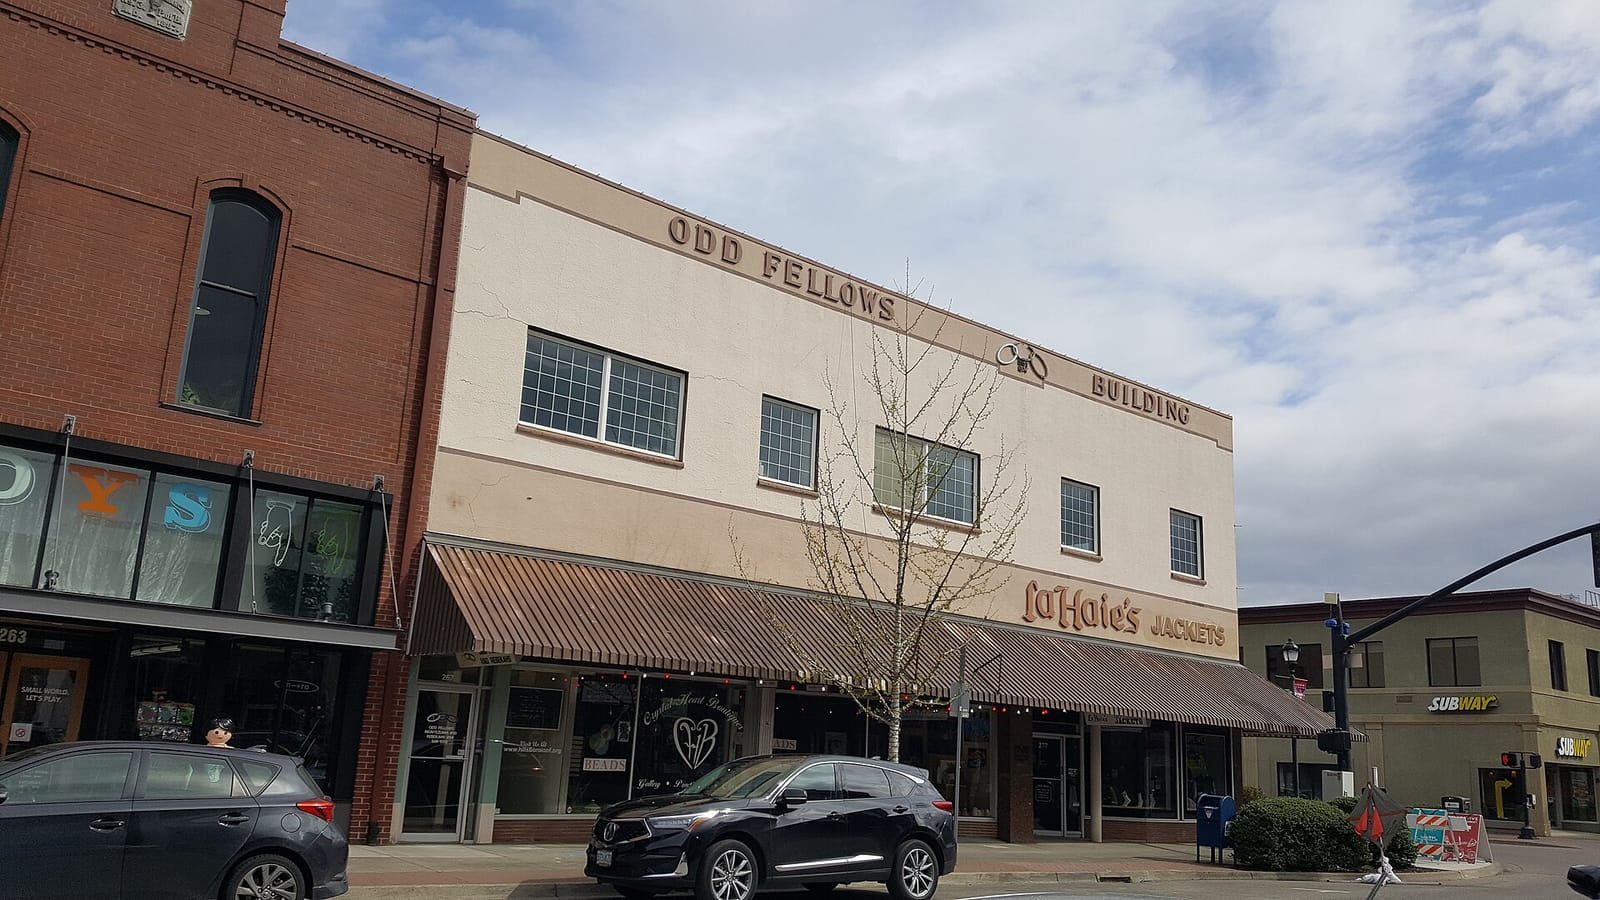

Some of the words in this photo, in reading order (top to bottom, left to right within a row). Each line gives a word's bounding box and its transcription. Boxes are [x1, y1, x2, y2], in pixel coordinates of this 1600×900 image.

[667, 215, 744, 265] ODD
[762, 250, 895, 321] FELLOWS
[1091, 372, 1190, 425] BUILDING
[1022, 579, 1142, 634] LaHaie's
[1150, 615, 1226, 647] JACKETS
[0, 628, 28, 643] 263
[21, 686, 42, 694] SMALL
[25, 694, 42, 702] LET'S
[675, 691, 705, 705] Heart
[1428, 695, 1497, 712] SUBWAY
[1557, 737, 1592, 759] SUBWAY
[584, 759, 626, 770] BEADS
